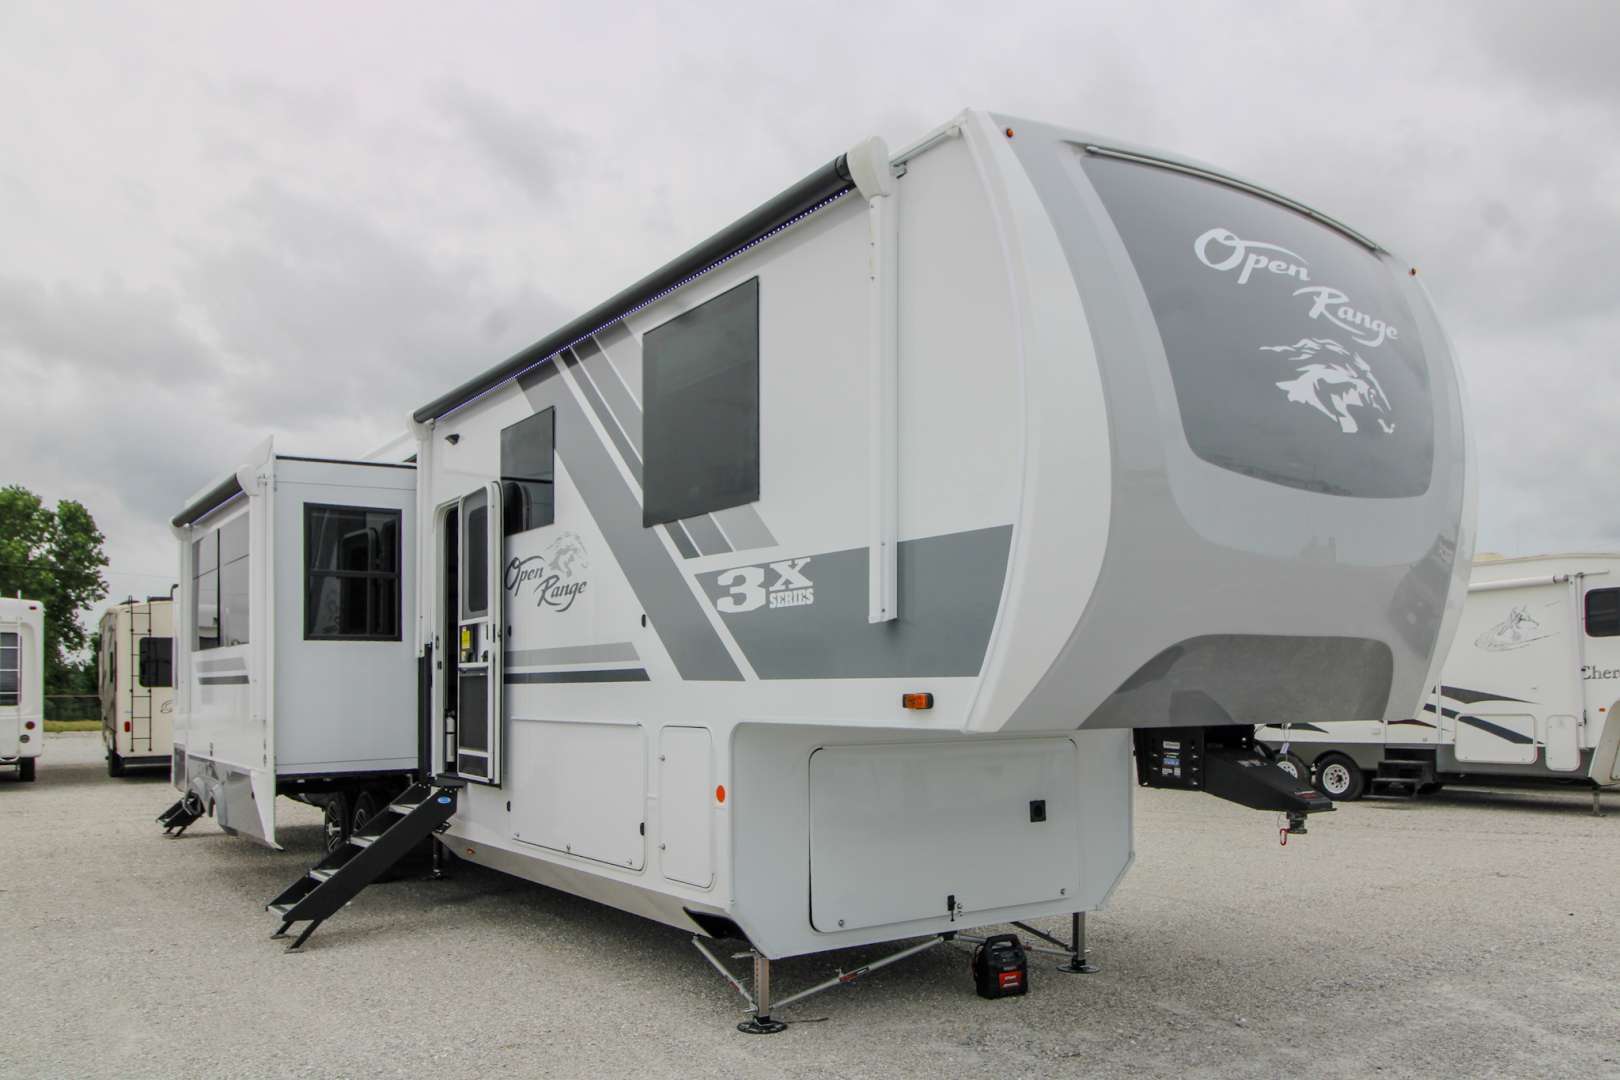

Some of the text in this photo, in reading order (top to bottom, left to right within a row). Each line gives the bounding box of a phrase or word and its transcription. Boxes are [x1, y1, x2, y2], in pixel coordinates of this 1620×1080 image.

[1194, 228, 1311, 284] Open
[1292, 286, 1398, 347] Range
[504, 555, 545, 597] Open
[533, 574, 587, 612] Range
[769, 588, 814, 608] SERIES
